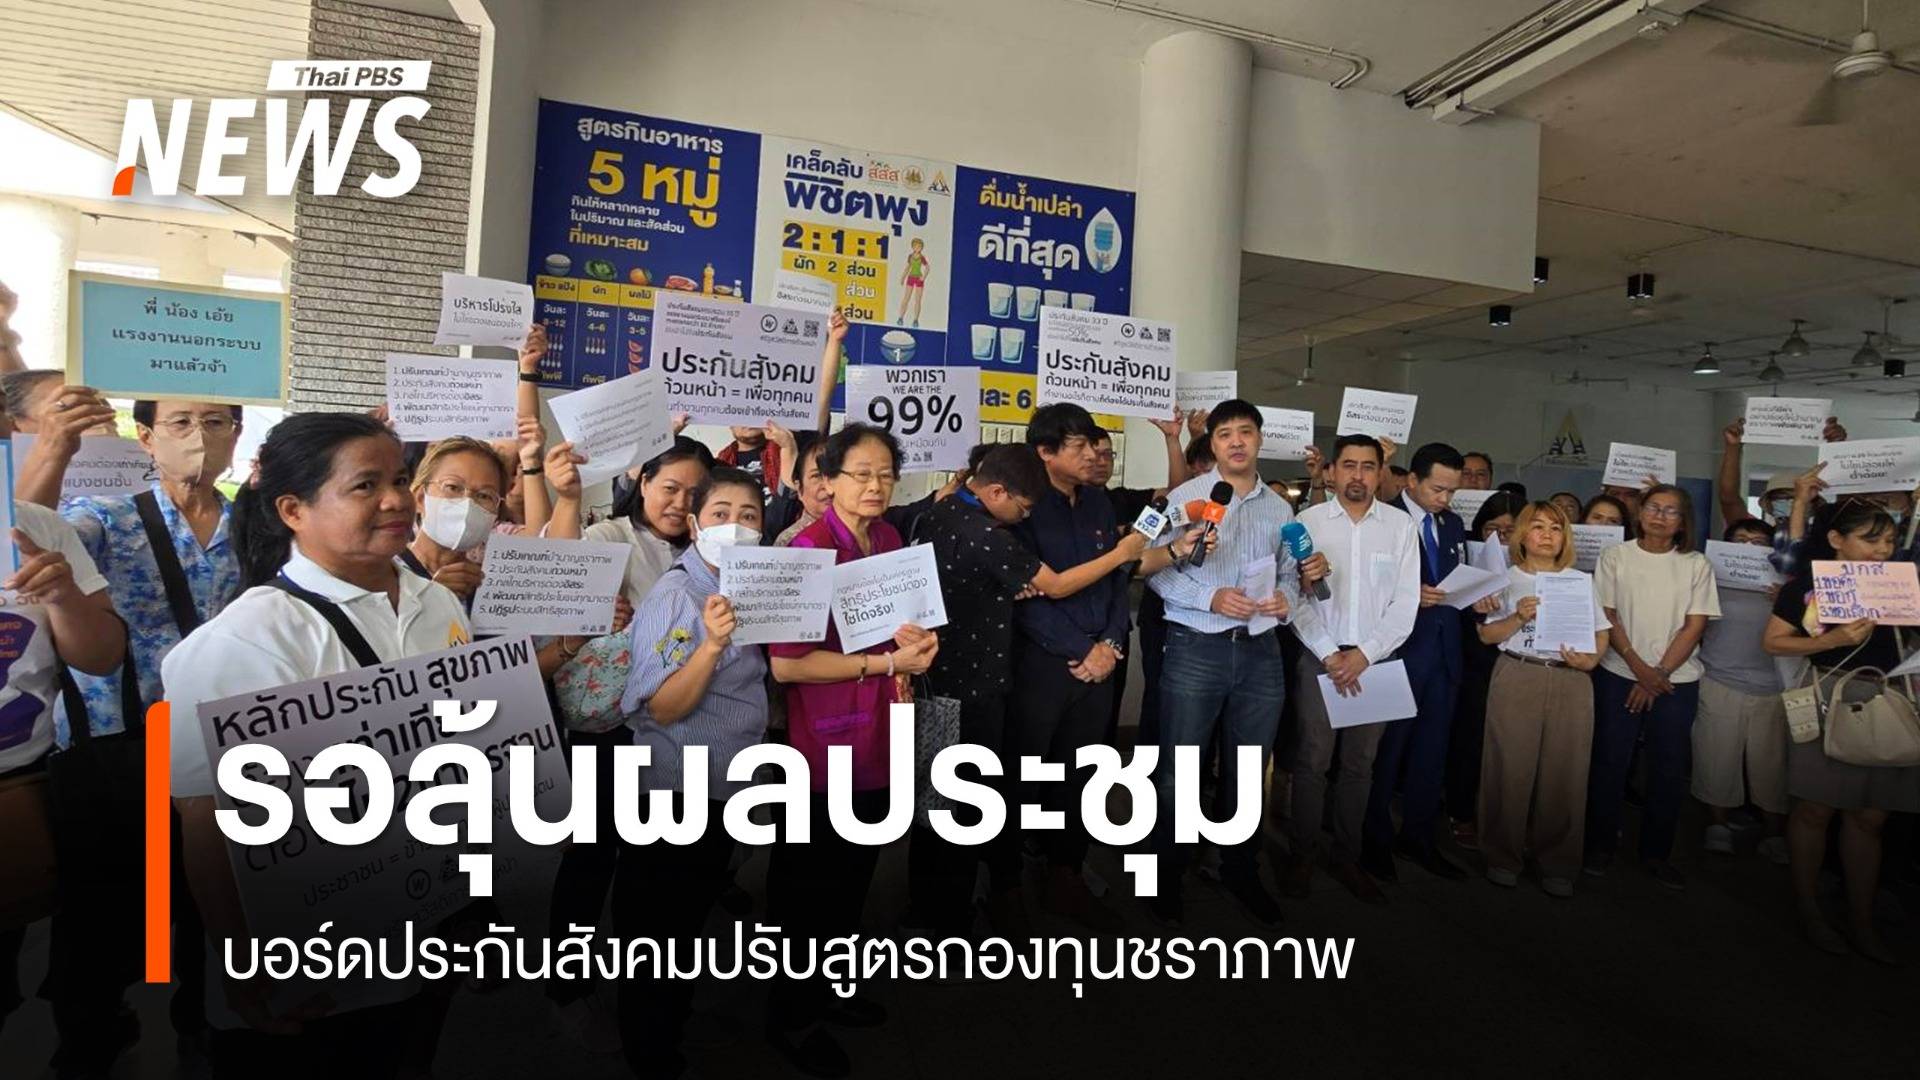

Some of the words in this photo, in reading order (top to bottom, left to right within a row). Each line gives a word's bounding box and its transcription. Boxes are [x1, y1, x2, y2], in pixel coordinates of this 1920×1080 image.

[577, 117, 724, 154] สูตรกินอาหาร
[785, 149, 863, 179] เคล็ดลับ
[588, 149, 624, 195] 5
[642, 155, 721, 229] หมู่
[978, 177, 1083, 220] ดื่มน้ำเปล่า
[571, 195, 660, 217] กินให้หลากหลาย
[784, 171, 929, 237] พิชิตพุง
[570, 209, 625, 227] ในปริมาณ
[627, 217, 685, 234] และสัดส่วน
[569, 222, 649, 252] ที่เหมาะสม
[977, 215, 1080, 281] ดีที่สุด
[793, 255, 815, 270] ผัก
[828, 261, 837, 272] 2
[847, 261, 876, 277] ส่วน
[845, 281, 876, 298] ส่วน
[164, 302, 199, 320] น้อง
[543, 304, 566, 314] วันละ
[844, 303, 874, 319] ส่วน
[112, 327, 262, 351] แรงงานนอกระบบ
[149, 357, 228, 374] มาแล้วจ้า
[662, 347, 815, 384] ประกันสังคม
[886, 369, 947, 383] พวกเรา
[1046, 349, 1171, 382] ประกันสังคม
[745, 380, 813, 407] เพื่อทุกคน
[892, 386, 907, 395] WE
[907, 386, 925, 395] ARE
[926, 386, 942, 395] THE
[1016, 389, 1032, 409] 6
[1045, 372, 1097, 391] ถ้วนหน้า
[1112, 377, 1171, 400] เพื่อทุกคน
[868, 394, 963, 436] 99%
[212, 668, 419, 747] หลักประกัน
[427, 638, 529, 699] สุขภาพ
